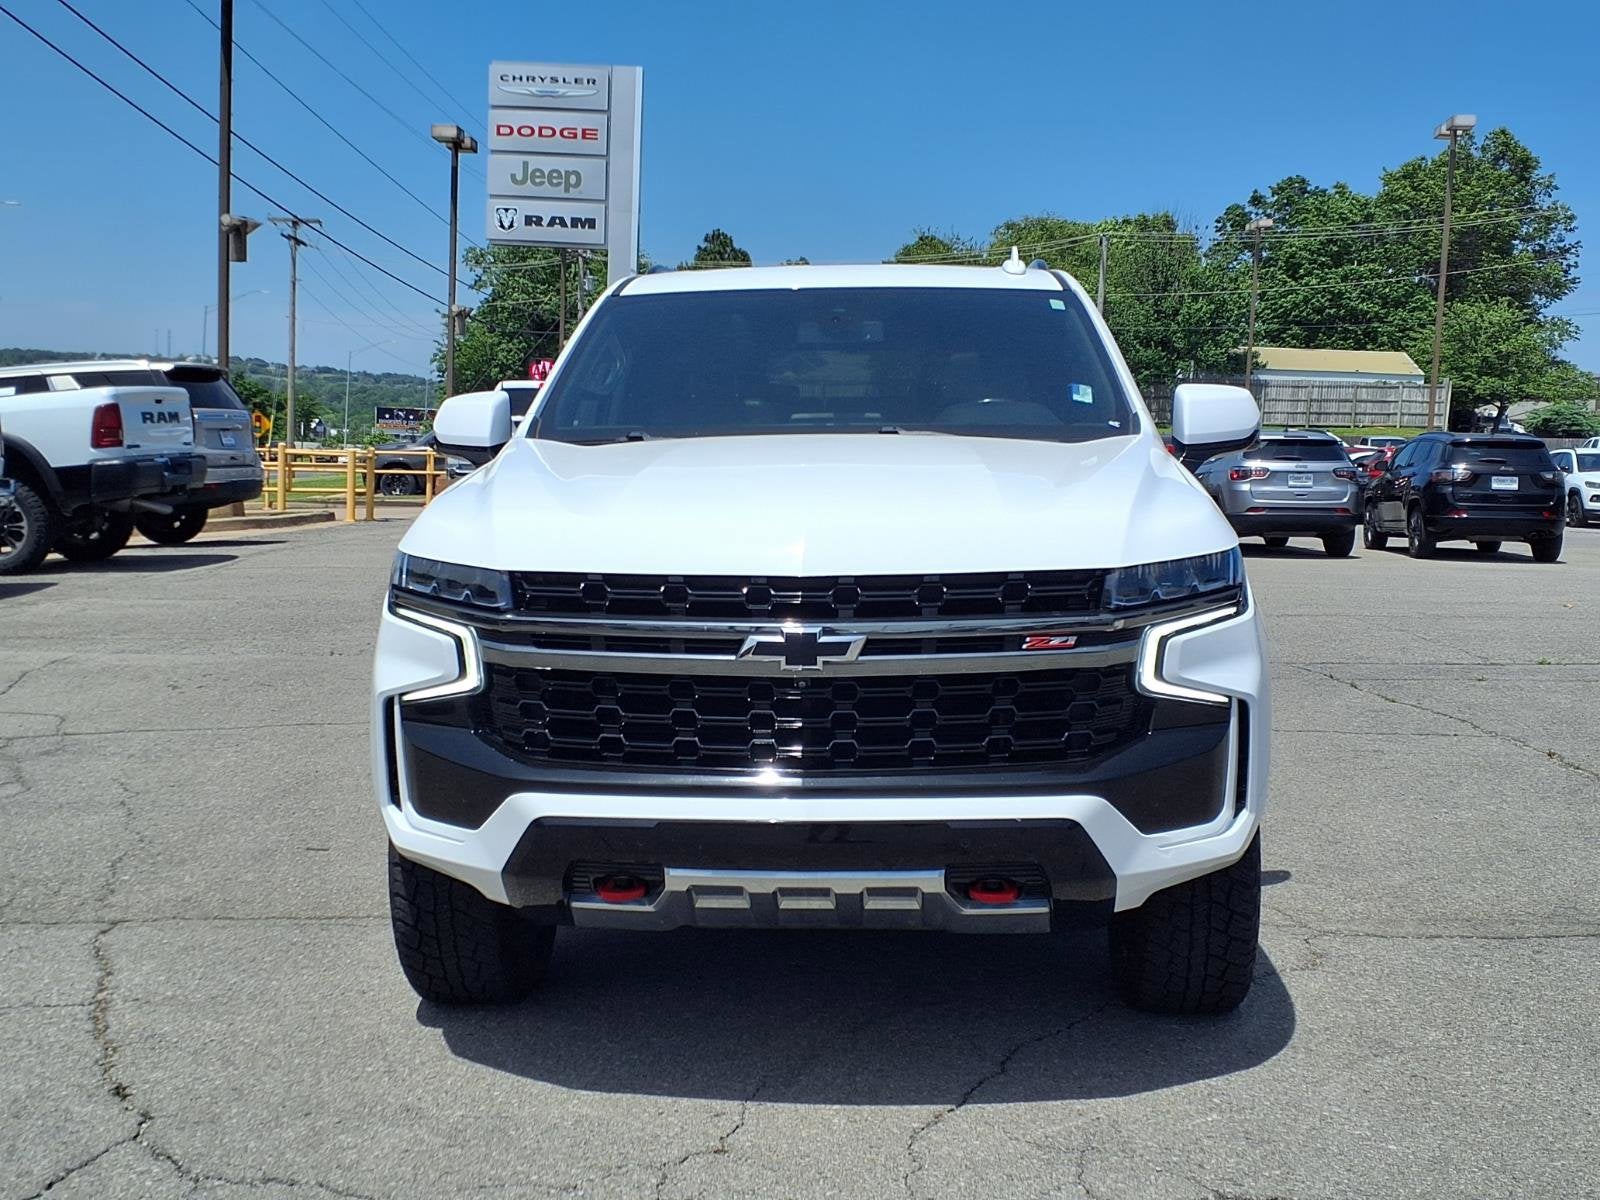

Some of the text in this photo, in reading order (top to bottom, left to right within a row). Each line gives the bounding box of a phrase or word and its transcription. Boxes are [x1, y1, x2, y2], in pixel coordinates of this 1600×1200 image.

[500, 74, 597, 86] CHRYSLER
[496, 124, 598, 140] DODGE
[510, 161, 582, 193] Jeep
[524, 215, 597, 230] RAM
[141, 411, 180, 424] RAM
[1022, 635, 1078, 649] Z71
